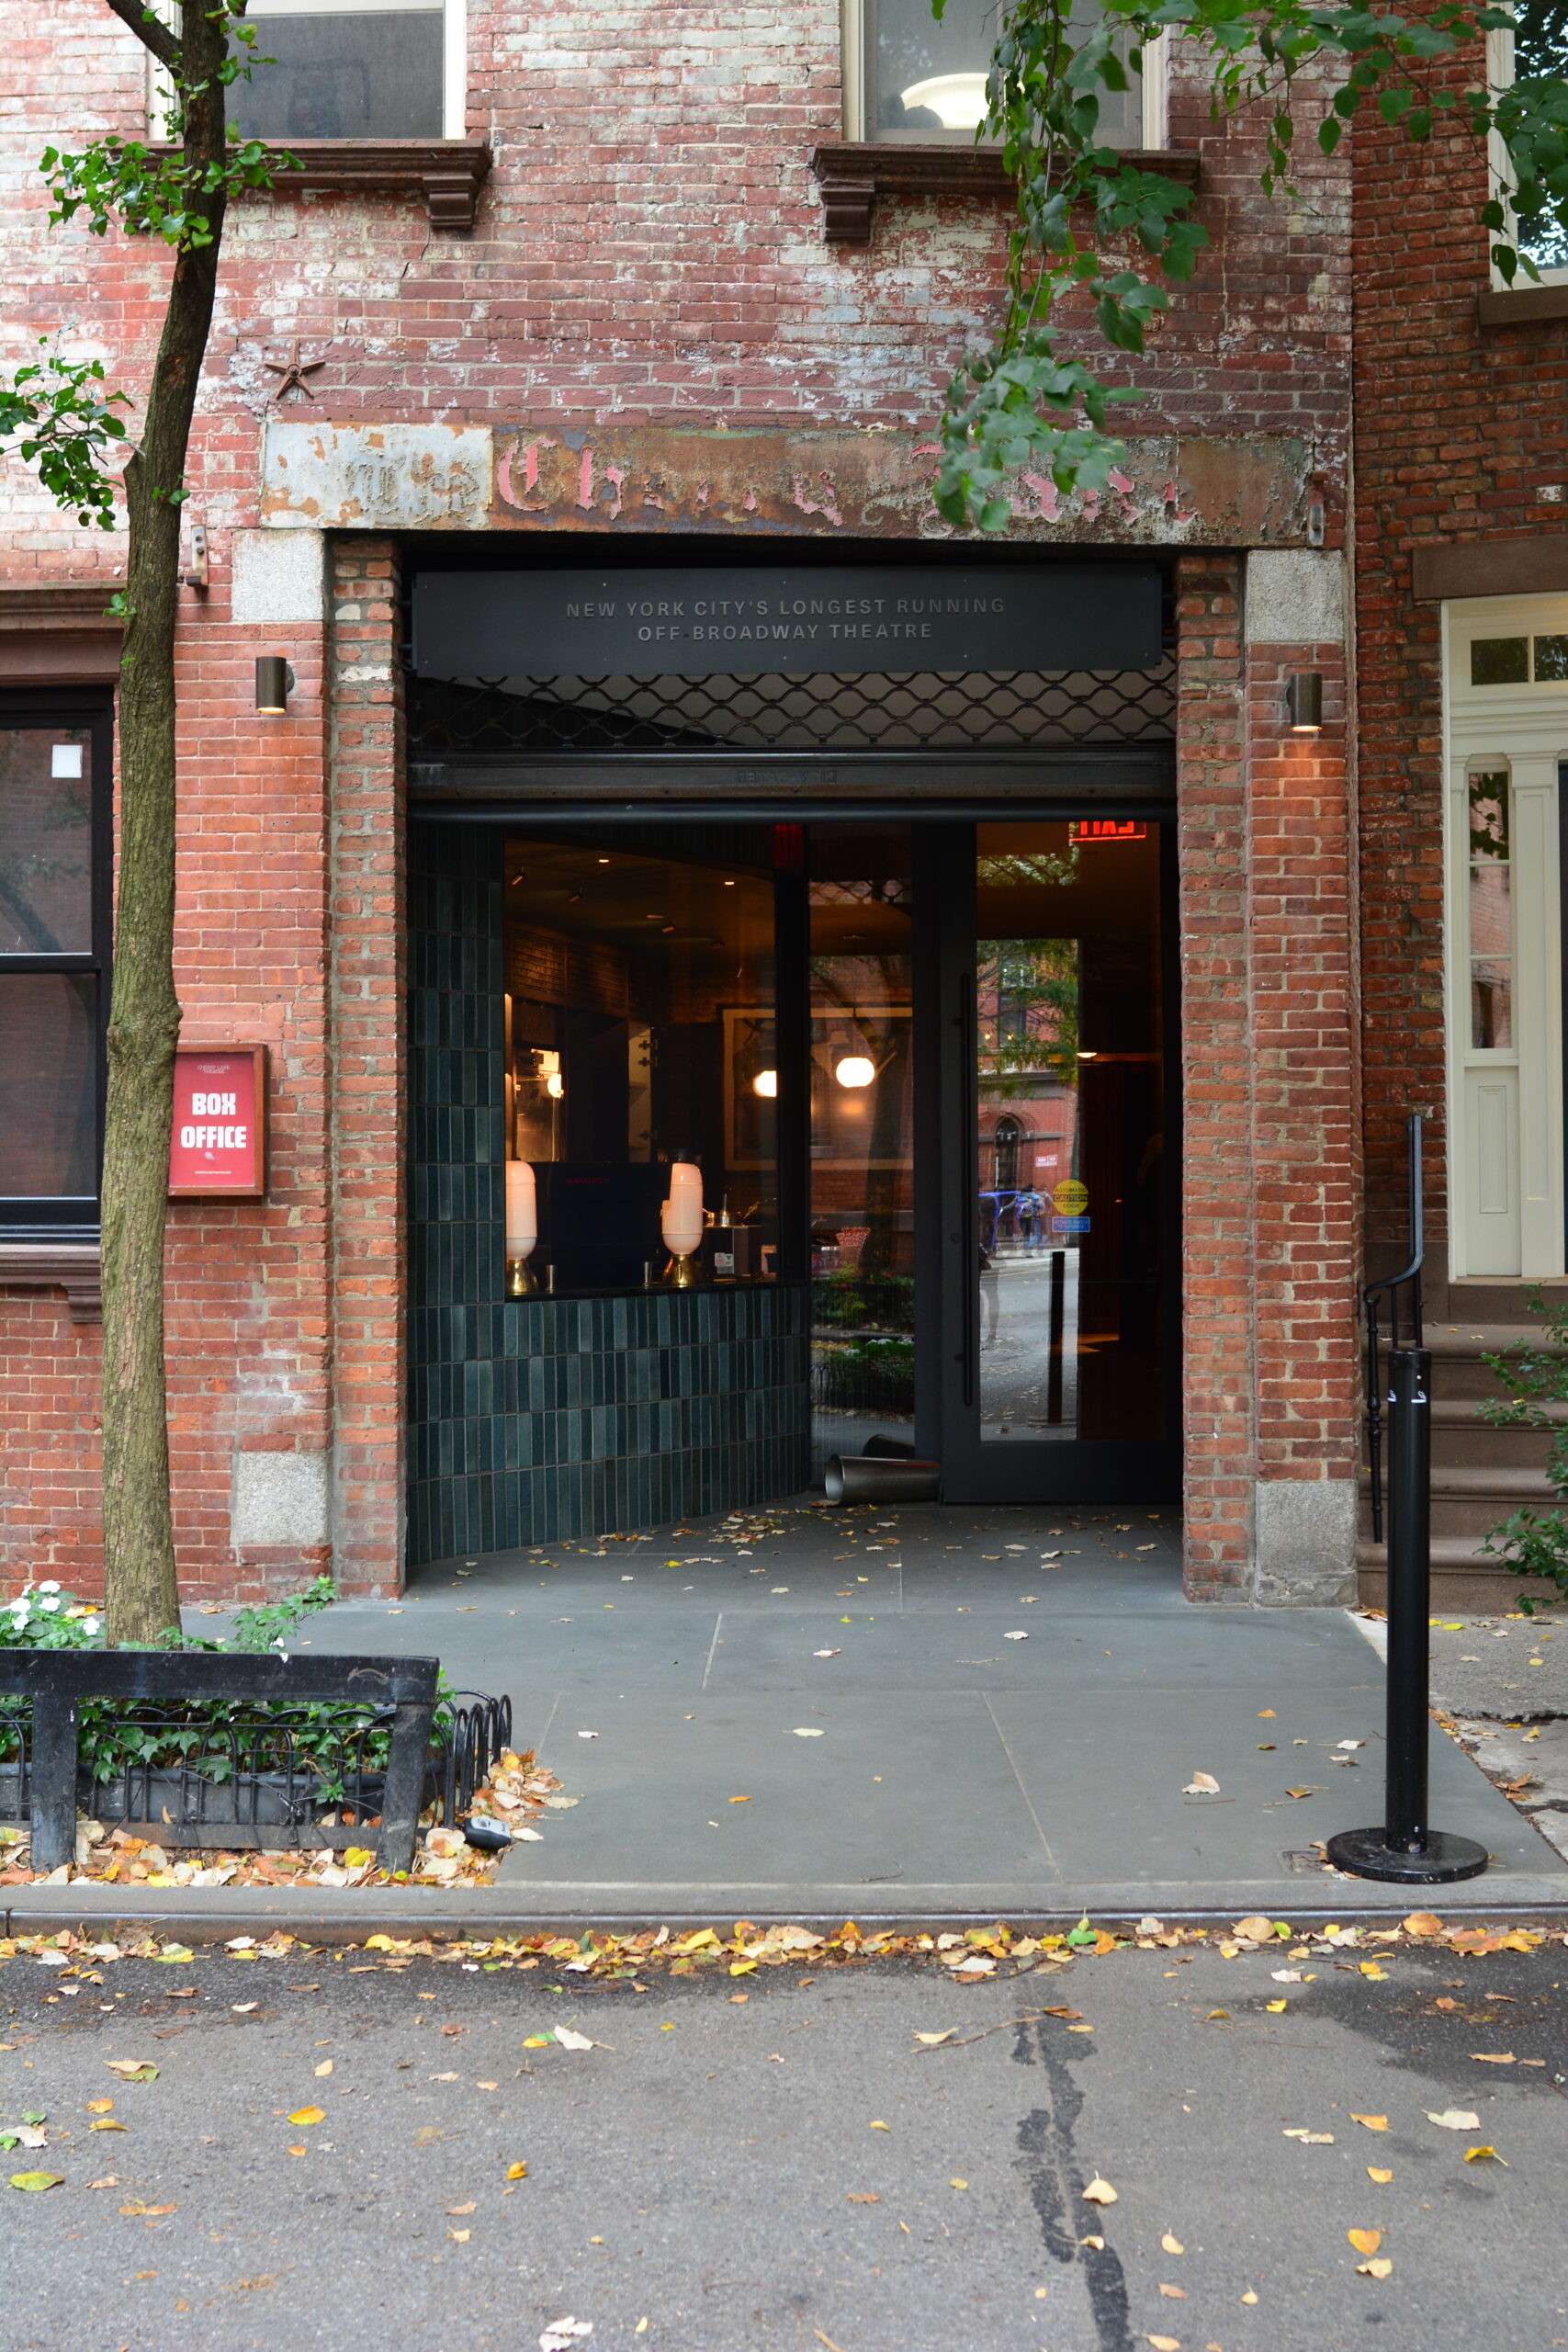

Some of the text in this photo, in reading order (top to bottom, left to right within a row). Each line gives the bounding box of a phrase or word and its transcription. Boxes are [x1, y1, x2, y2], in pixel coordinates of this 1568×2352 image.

[566, 598, 1005, 617] NEW YORK CITY'S LONGEST RUNNING
[638, 624, 932, 641] OFF-BROADWAY THEATRE
[192, 1092, 236, 1115] BOX
[181, 1125, 247, 1148] OFFICE
